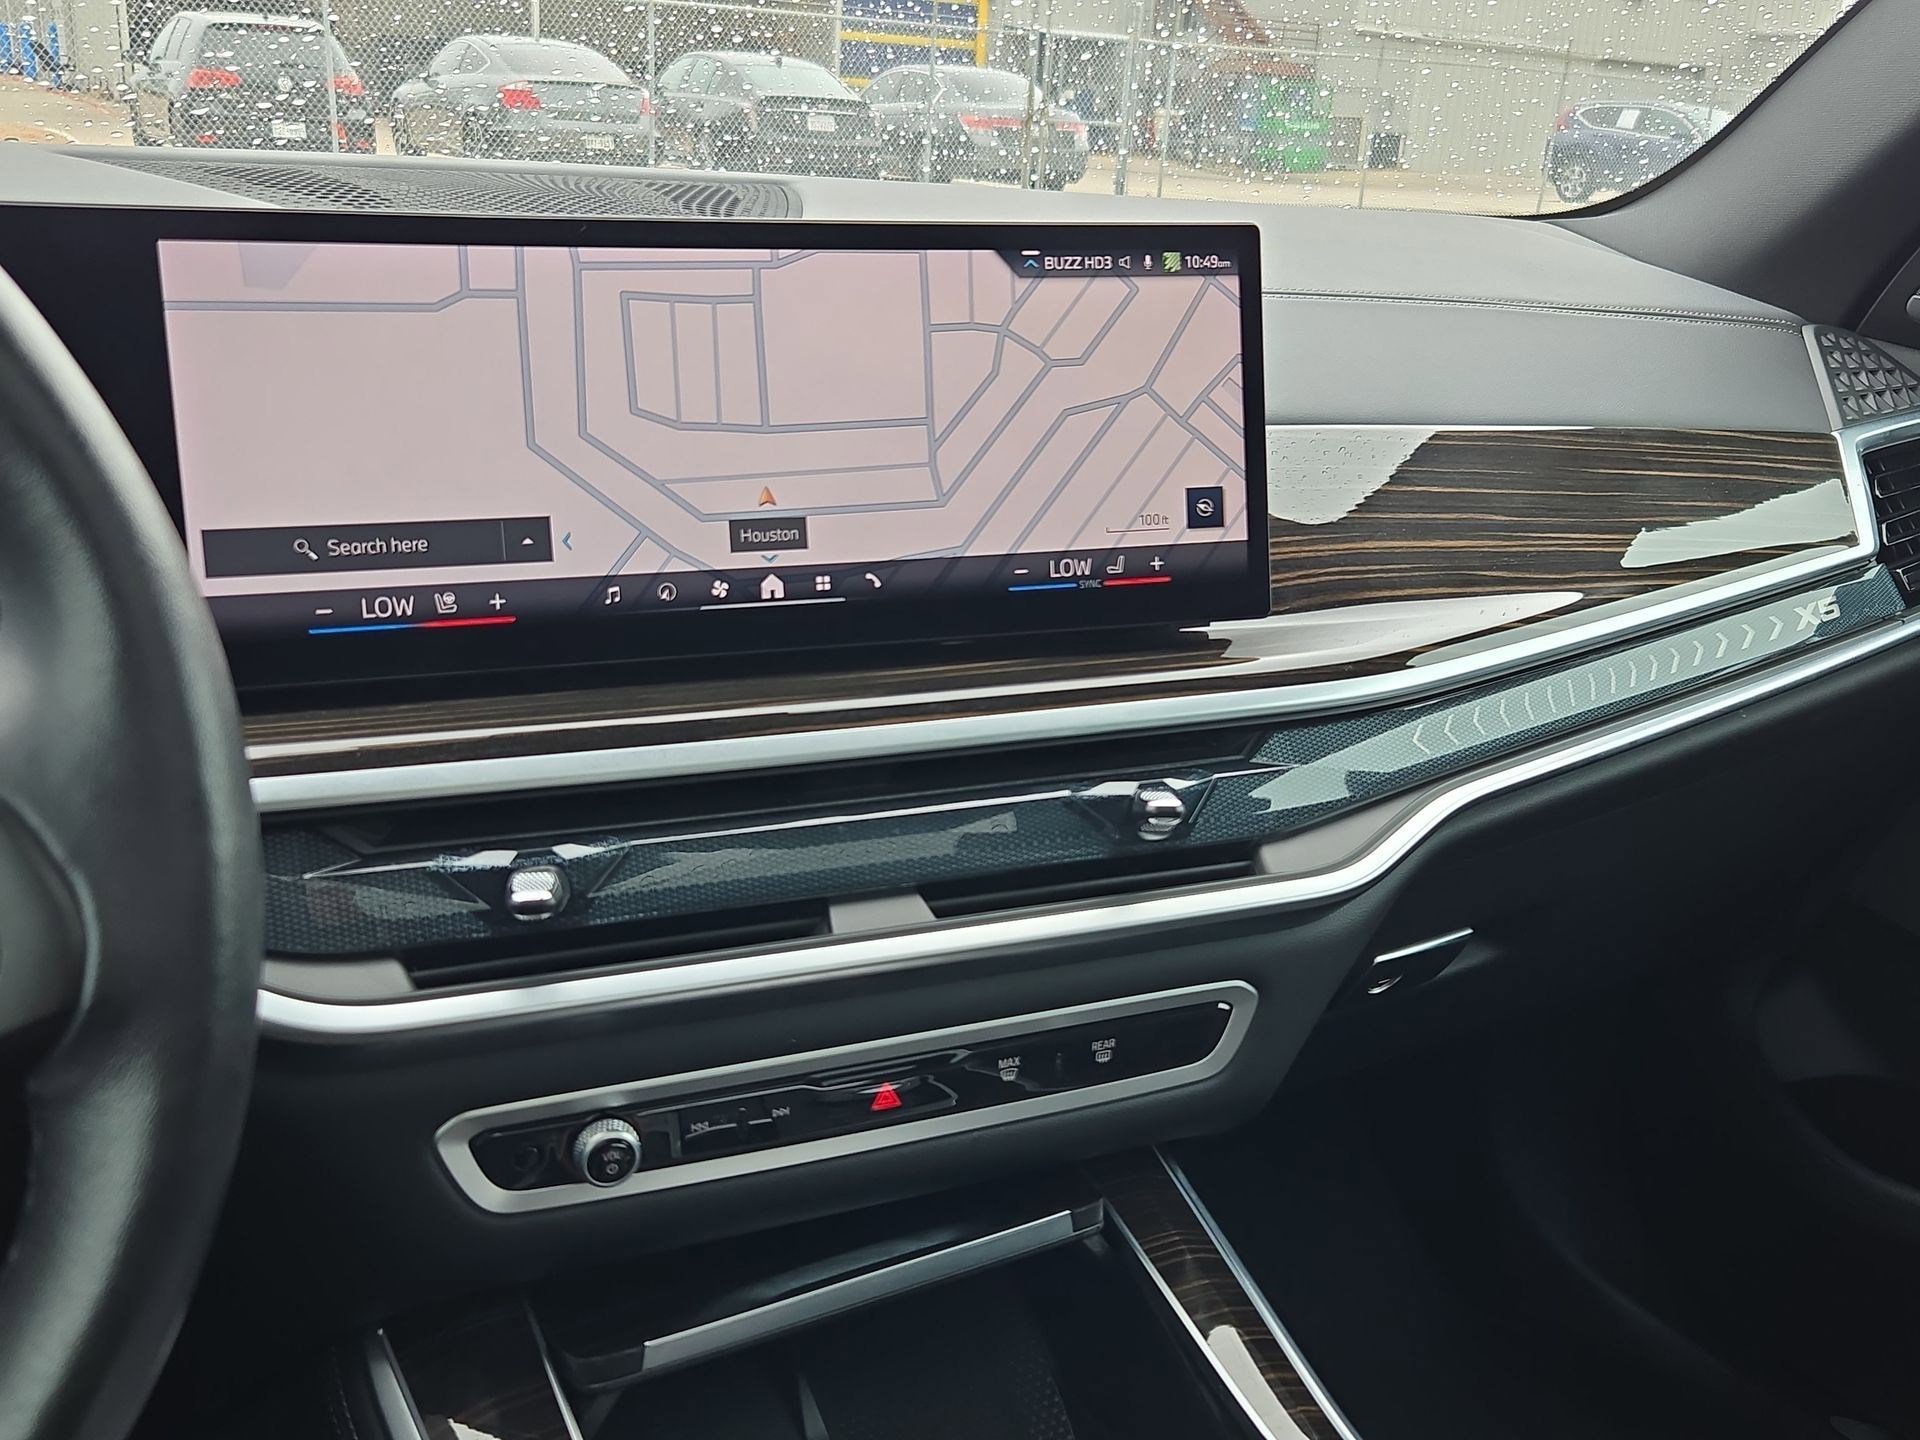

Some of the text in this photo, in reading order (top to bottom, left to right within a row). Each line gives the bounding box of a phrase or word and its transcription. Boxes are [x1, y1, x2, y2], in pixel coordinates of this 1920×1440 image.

[1044, 256, 1113, 270] BUZZ HD3
[740, 528, 800, 543] Houston
[327, 537, 429, 557] Search here
[1049, 558, 1092, 578] LOW
[1079, 579, 1102, 589] SYNC
[361, 595, 415, 619] LOW
[1793, 595, 1841, 632] X5
[1092, 1038, 1116, 1051] REAR
[998, 1056, 1021, 1069] MAX
